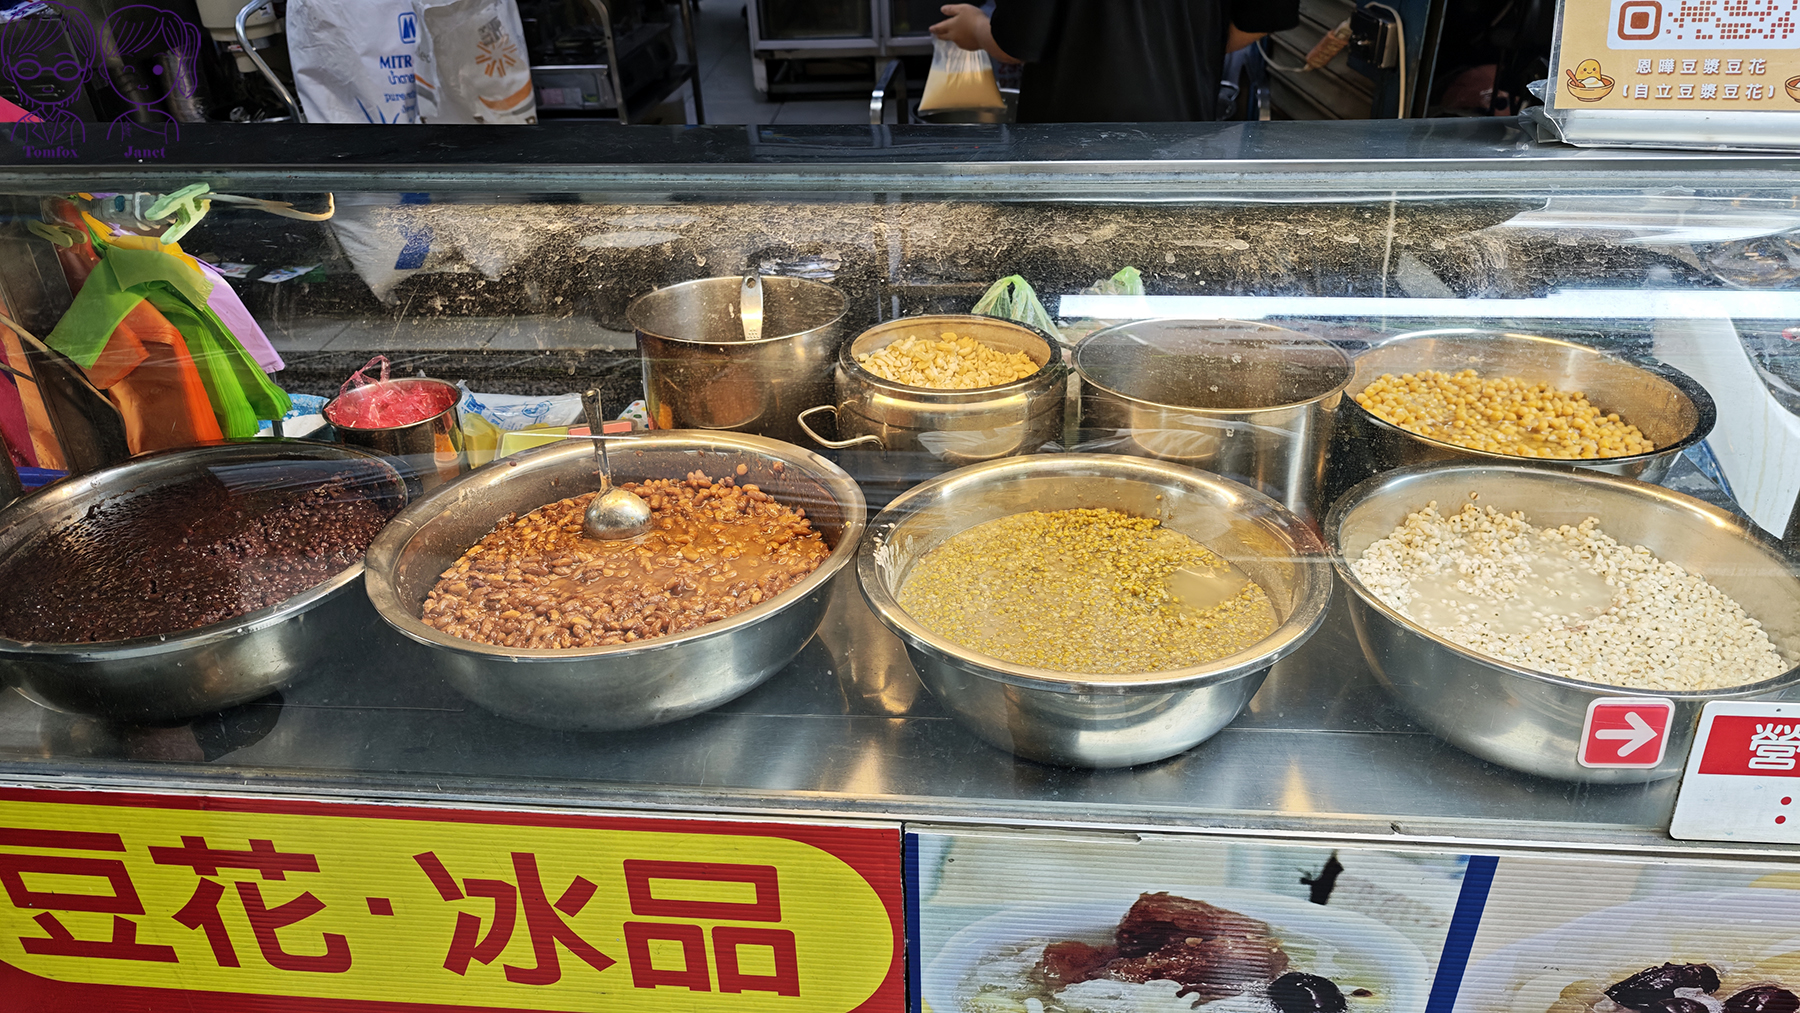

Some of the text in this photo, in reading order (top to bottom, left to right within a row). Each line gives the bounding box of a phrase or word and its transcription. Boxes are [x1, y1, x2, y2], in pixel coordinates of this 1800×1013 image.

[379, 55, 413, 69] MITR
[1636, 58, 1767, 75] 恩曄豆漿豆花
